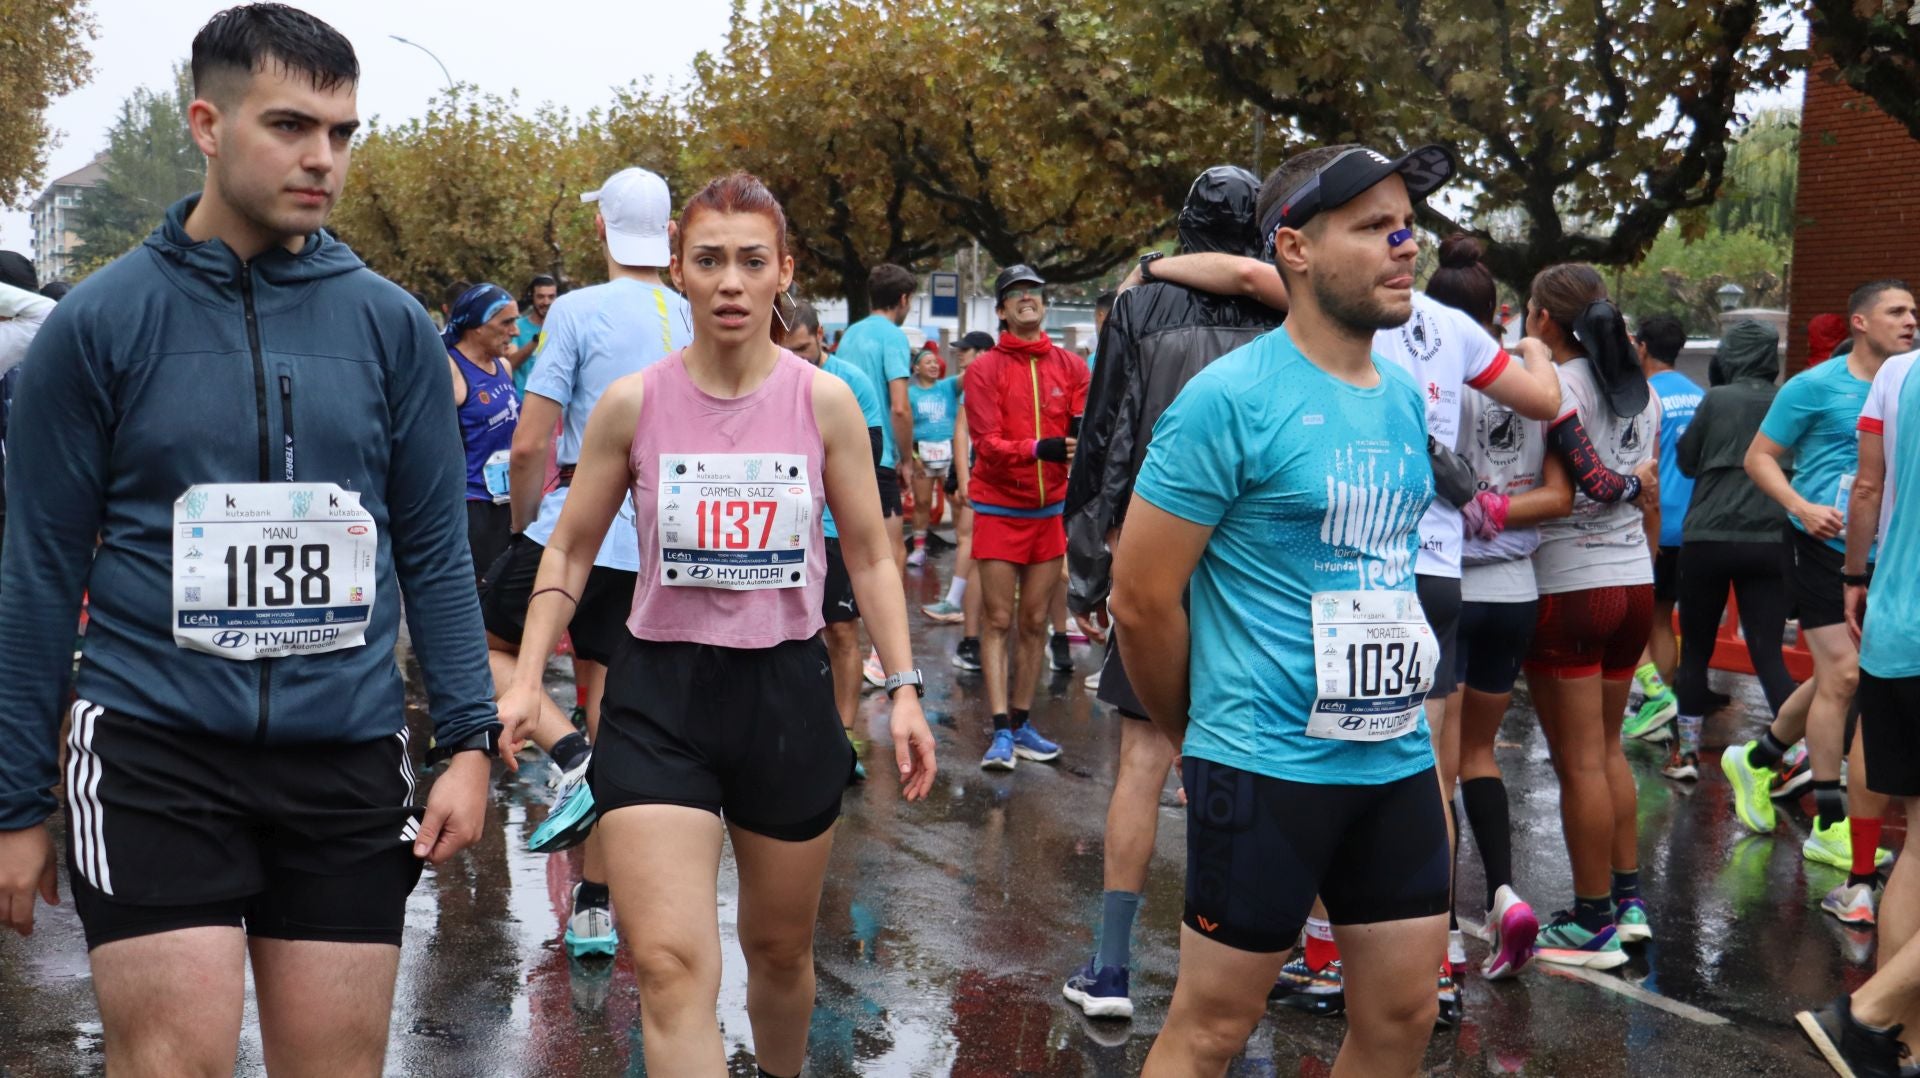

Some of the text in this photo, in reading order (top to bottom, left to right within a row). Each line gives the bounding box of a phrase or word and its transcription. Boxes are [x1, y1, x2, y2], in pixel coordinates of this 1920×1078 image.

[284, 446, 294, 482] TERREX
[700, 487, 775, 498] CARMEN SAIZ
[226, 493, 339, 508] k k
[225, 509, 271, 518] kutxabank
[696, 500, 778, 549] 1137
[262, 527, 298, 540] MANU
[1314, 559, 1358, 572] Hyundai
[224, 544, 331, 608] 1138
[717, 568, 784, 579] HYUNDAI
[255, 628, 339, 645] HYUNDAI
[255, 644, 289, 654] Lemauto
[1346, 642, 1421, 697] 1034
[1369, 712, 1411, 729] HYUNDAI
